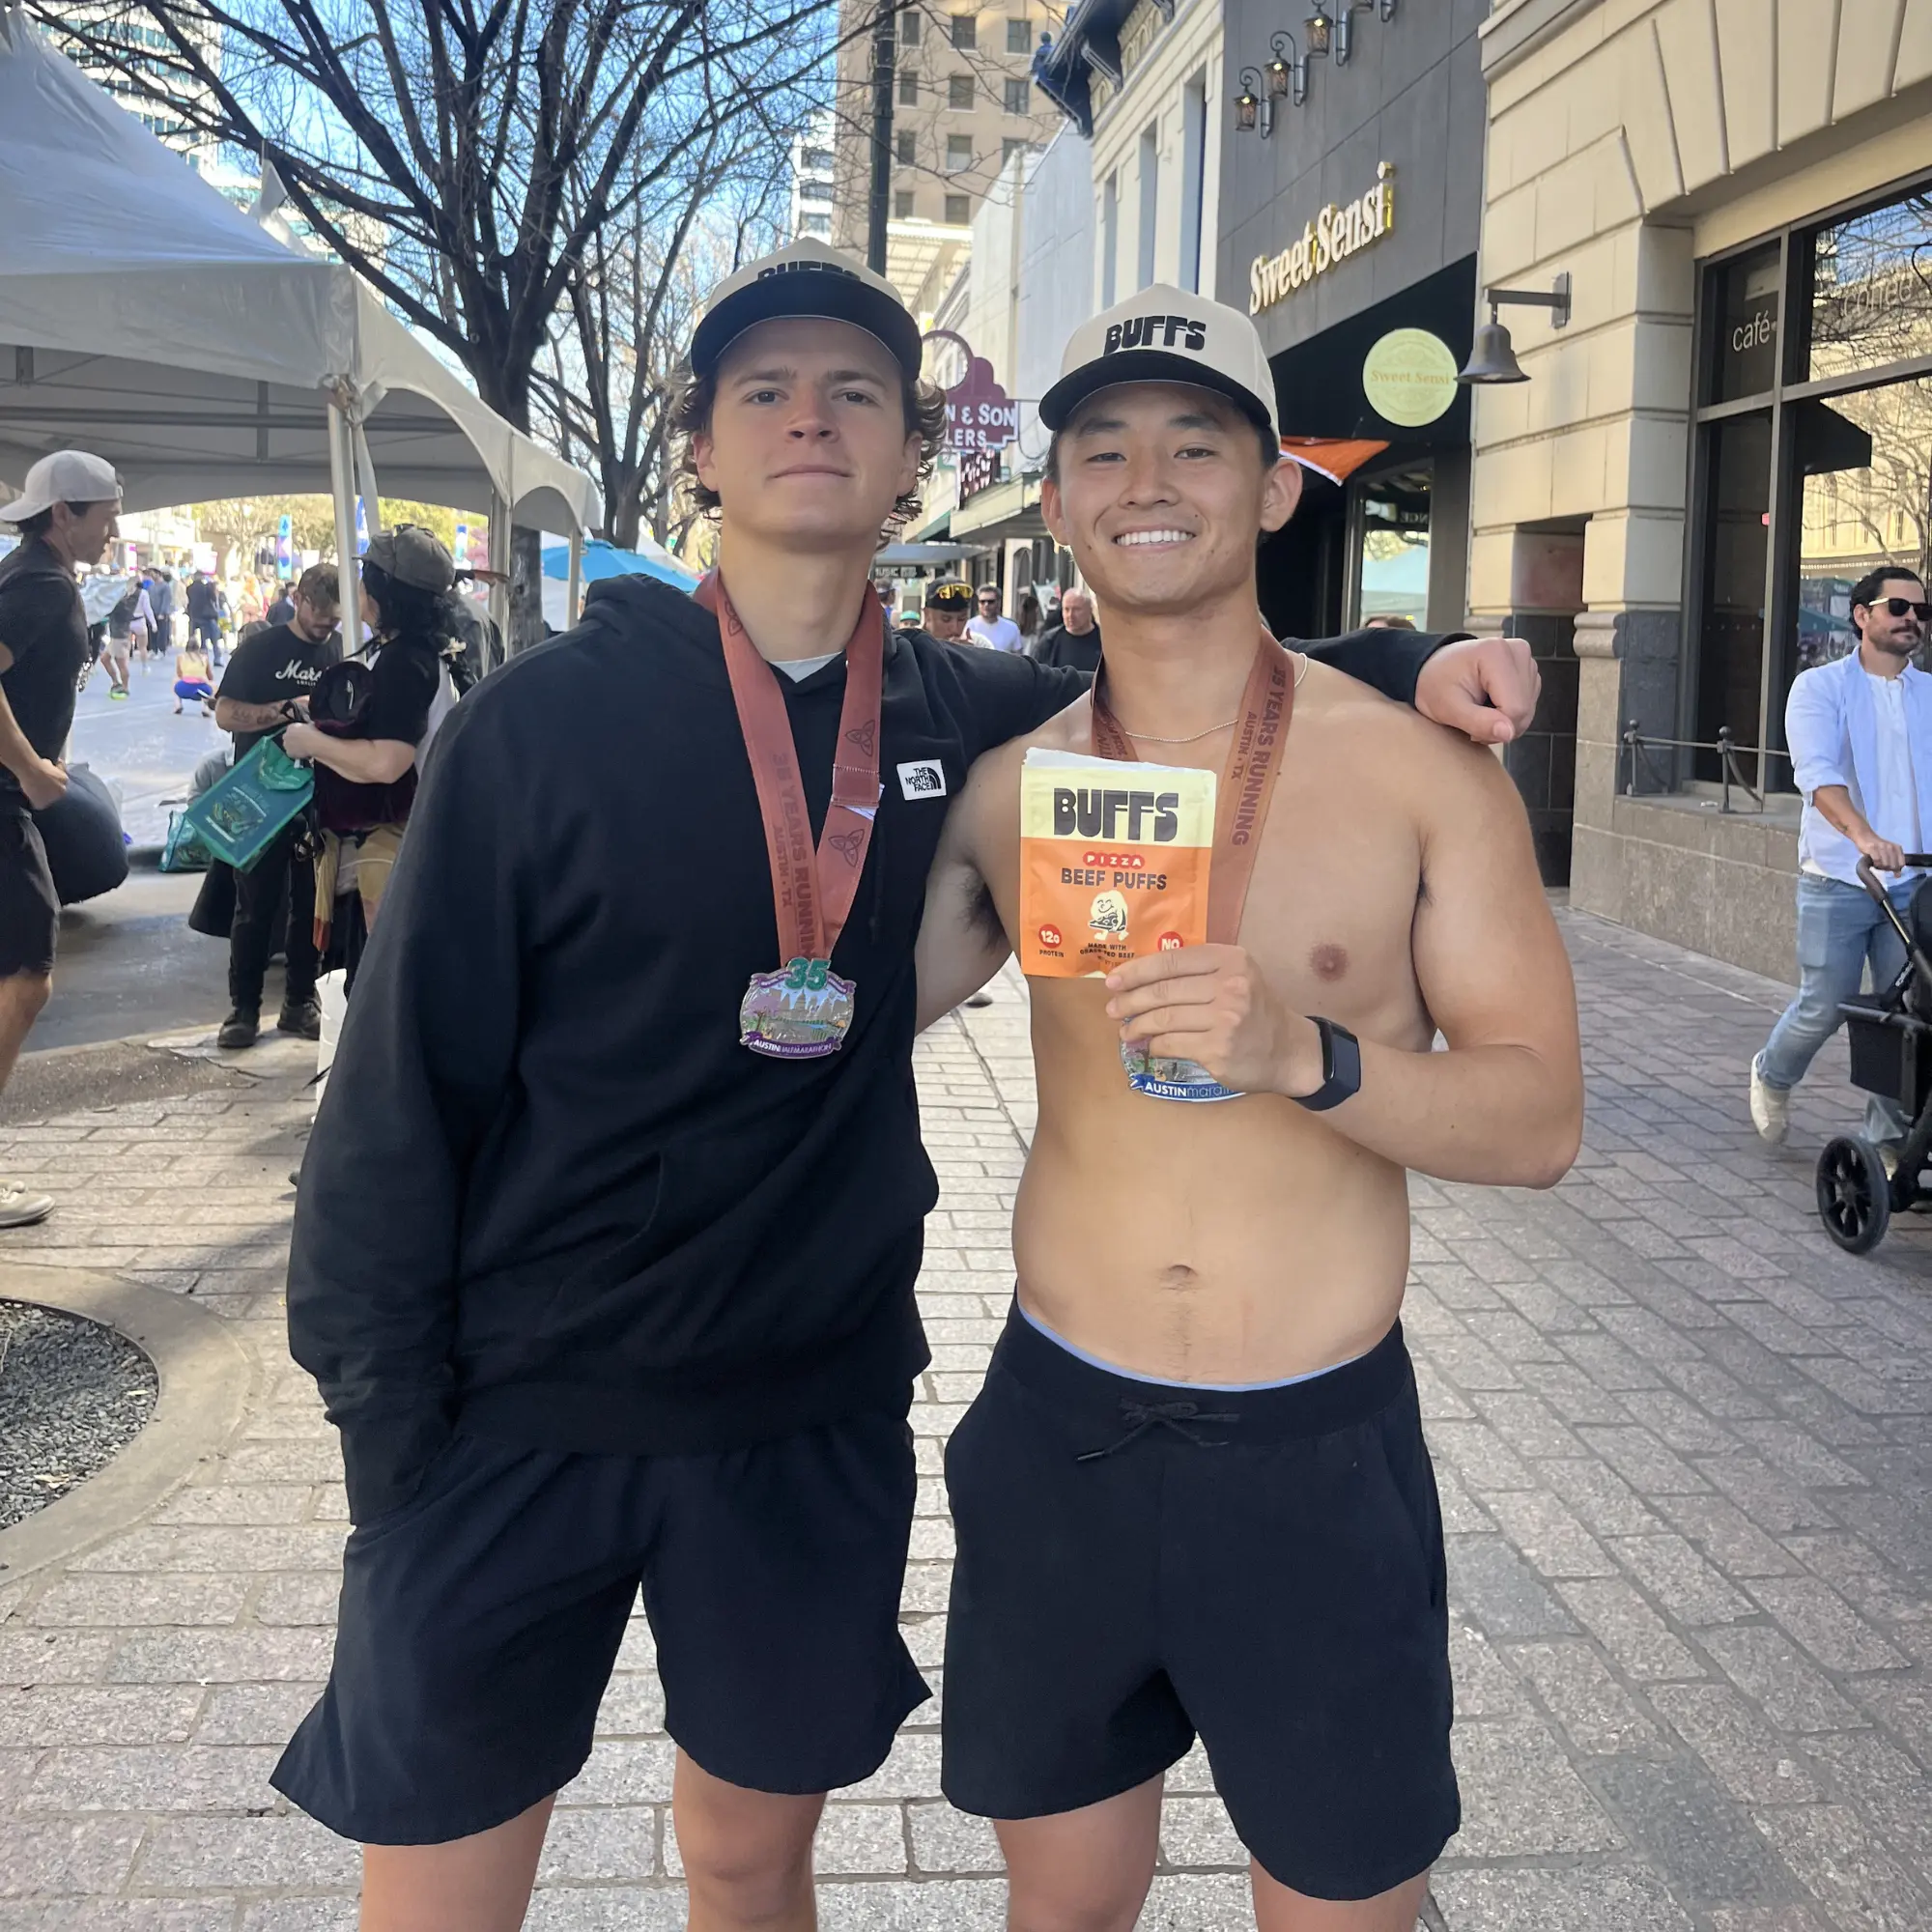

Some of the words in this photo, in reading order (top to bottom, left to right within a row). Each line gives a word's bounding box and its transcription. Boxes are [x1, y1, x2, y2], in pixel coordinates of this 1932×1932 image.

[1249, 220, 1315, 317] Sweet
[1316, 160, 1391, 275] Sensi
[1103, 315, 1207, 356] BUFFS
[1732, 309, 1771, 353] café
[1372, 370, 1410, 384] Sweet
[1414, 372, 1449, 385] Sensi
[978, 403, 1015, 427] SON
[1237, 710, 1258, 755] AUSTIN
[1257, 690, 1286, 747] YEARS
[904, 774, 930, 785] NORTH
[913, 766, 928, 776] THE
[1231, 763, 1244, 781] TX
[914, 781, 931, 792] FACE
[1231, 750, 1271, 846] RUNNING
[781, 784, 807, 862] YEARS
[1053, 787, 1179, 842] BUFFS
[773, 825, 789, 878] AUSTIN
[781, 887, 793, 908] TX
[1087, 855, 1142, 867] PIZZA
[1061, 867, 1106, 886] BEEF
[1113, 871, 1167, 890] PUFFS
[1038, 949, 1065, 958] PROTEIN
[1161, 938, 1179, 952] NO
[784, 957, 831, 992] 35
